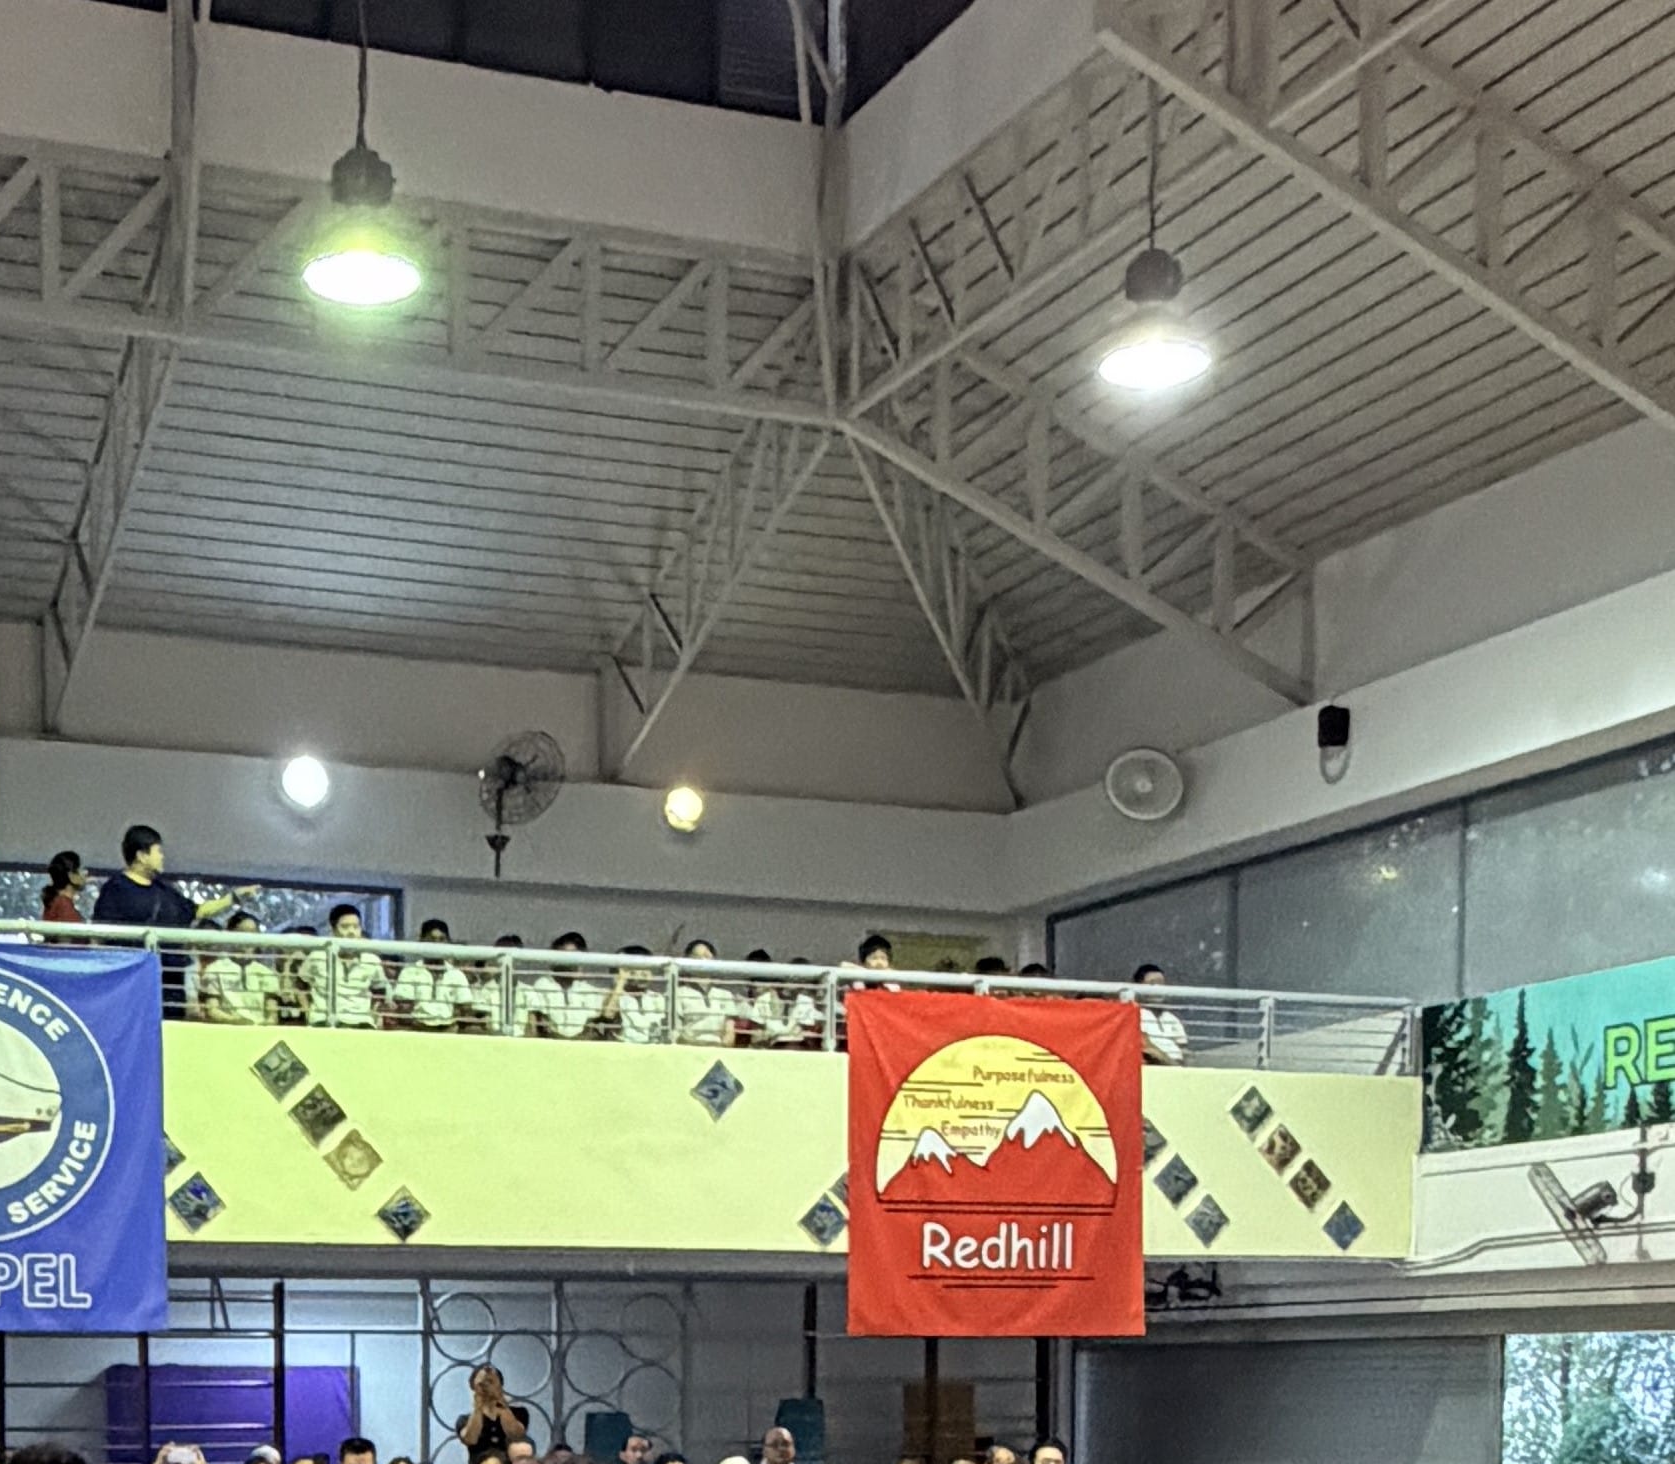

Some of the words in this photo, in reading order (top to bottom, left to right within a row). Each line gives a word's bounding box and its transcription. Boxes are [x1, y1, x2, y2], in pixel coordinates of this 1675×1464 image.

[1603, 1013, 1675, 1090] RE
[972, 1065, 1076, 1086] Purposefulness
[903, 1094, 995, 1112] Thankfulness
[940, 1120, 1003, 1140] Empathy
[6, 1119, 98, 1225] SERVICE
[921, 1221, 1074, 1273] Redhill
